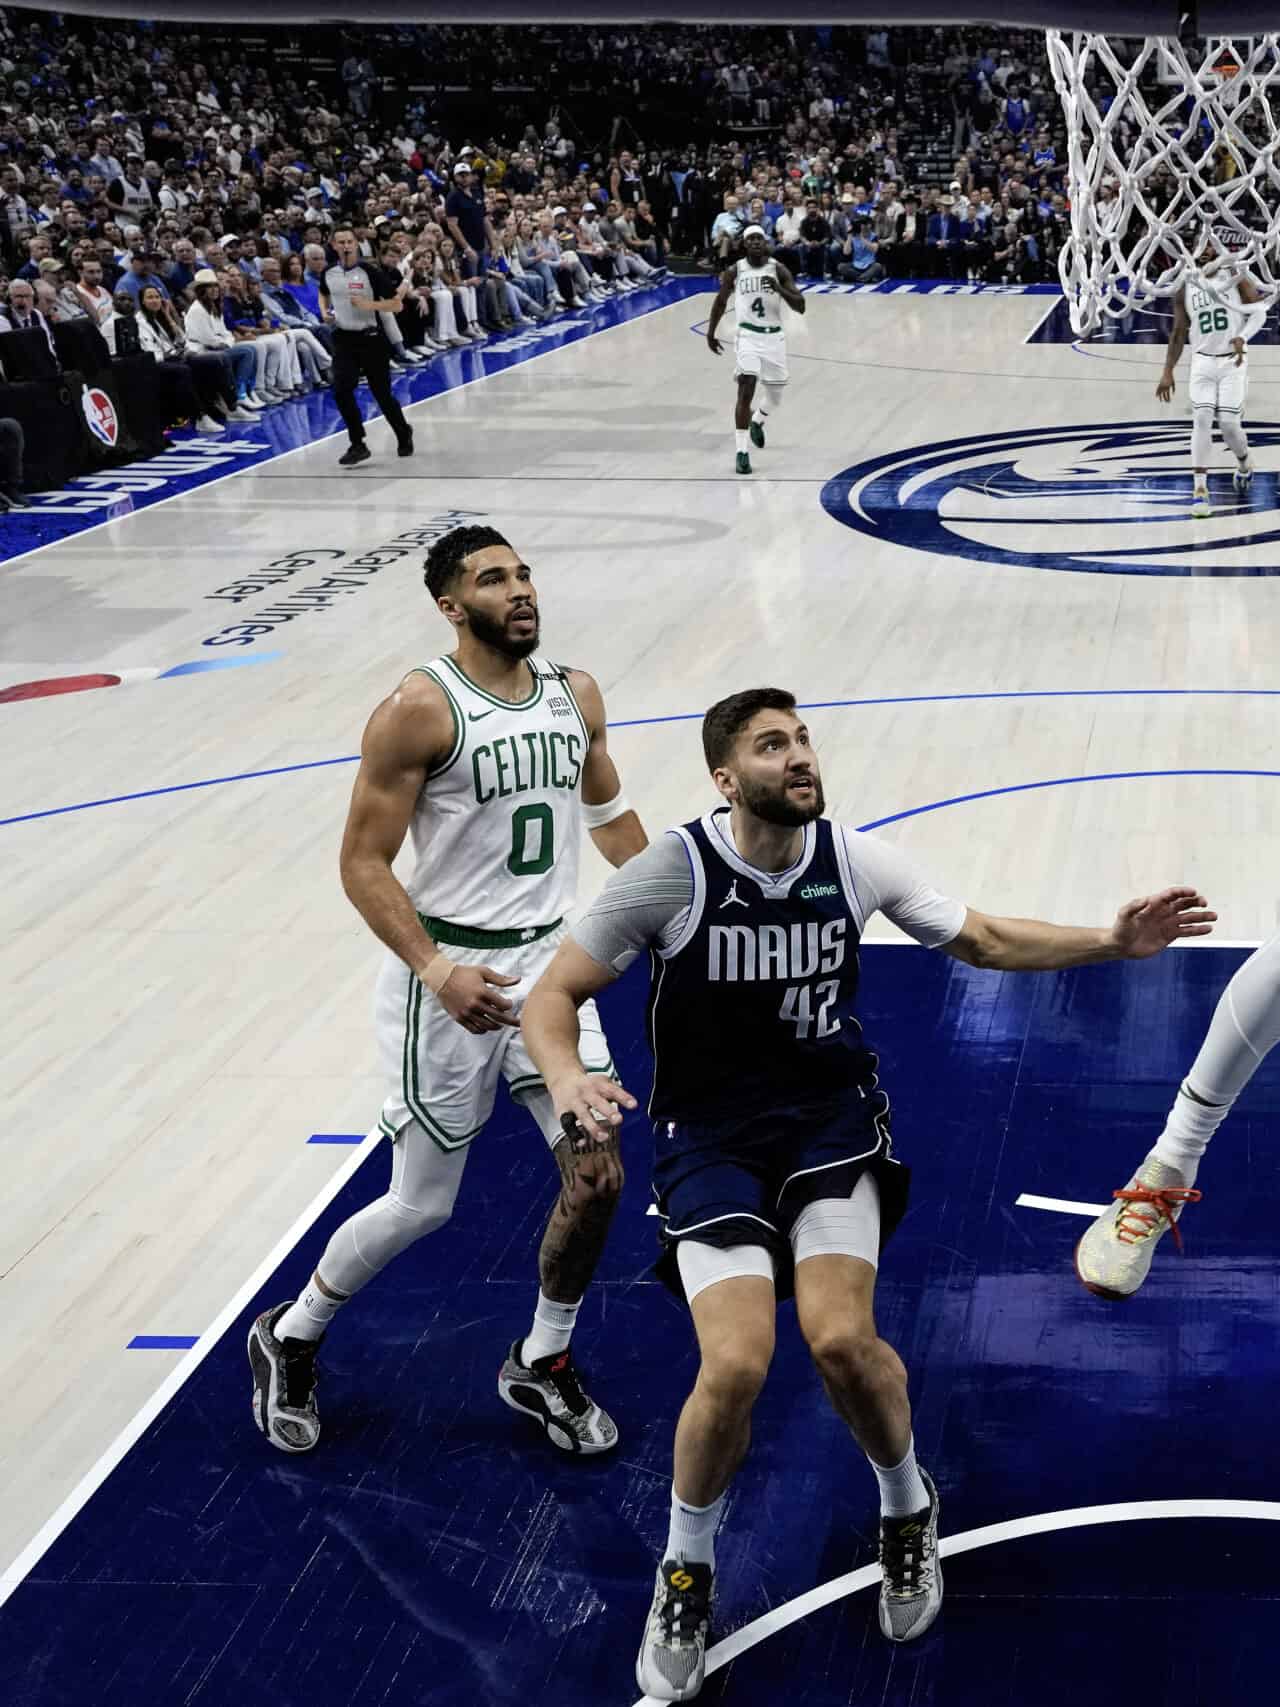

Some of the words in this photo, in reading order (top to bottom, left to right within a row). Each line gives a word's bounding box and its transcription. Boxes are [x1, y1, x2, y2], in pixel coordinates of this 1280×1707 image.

[740, 277, 775, 295] CELT
[751, 297, 765, 318] 4
[797, 284, 1028, 295] ALLAS
[1199, 308, 1228, 334] 26
[203, 549, 346, 603] Center
[202, 577, 368, 646] Airlines
[472, 732, 581, 805] CELTICS
[507, 802, 554, 876] 0
[800, 883, 839, 899] chime
[708, 918, 847, 982] MAVS
[779, 979, 842, 1039] 42
